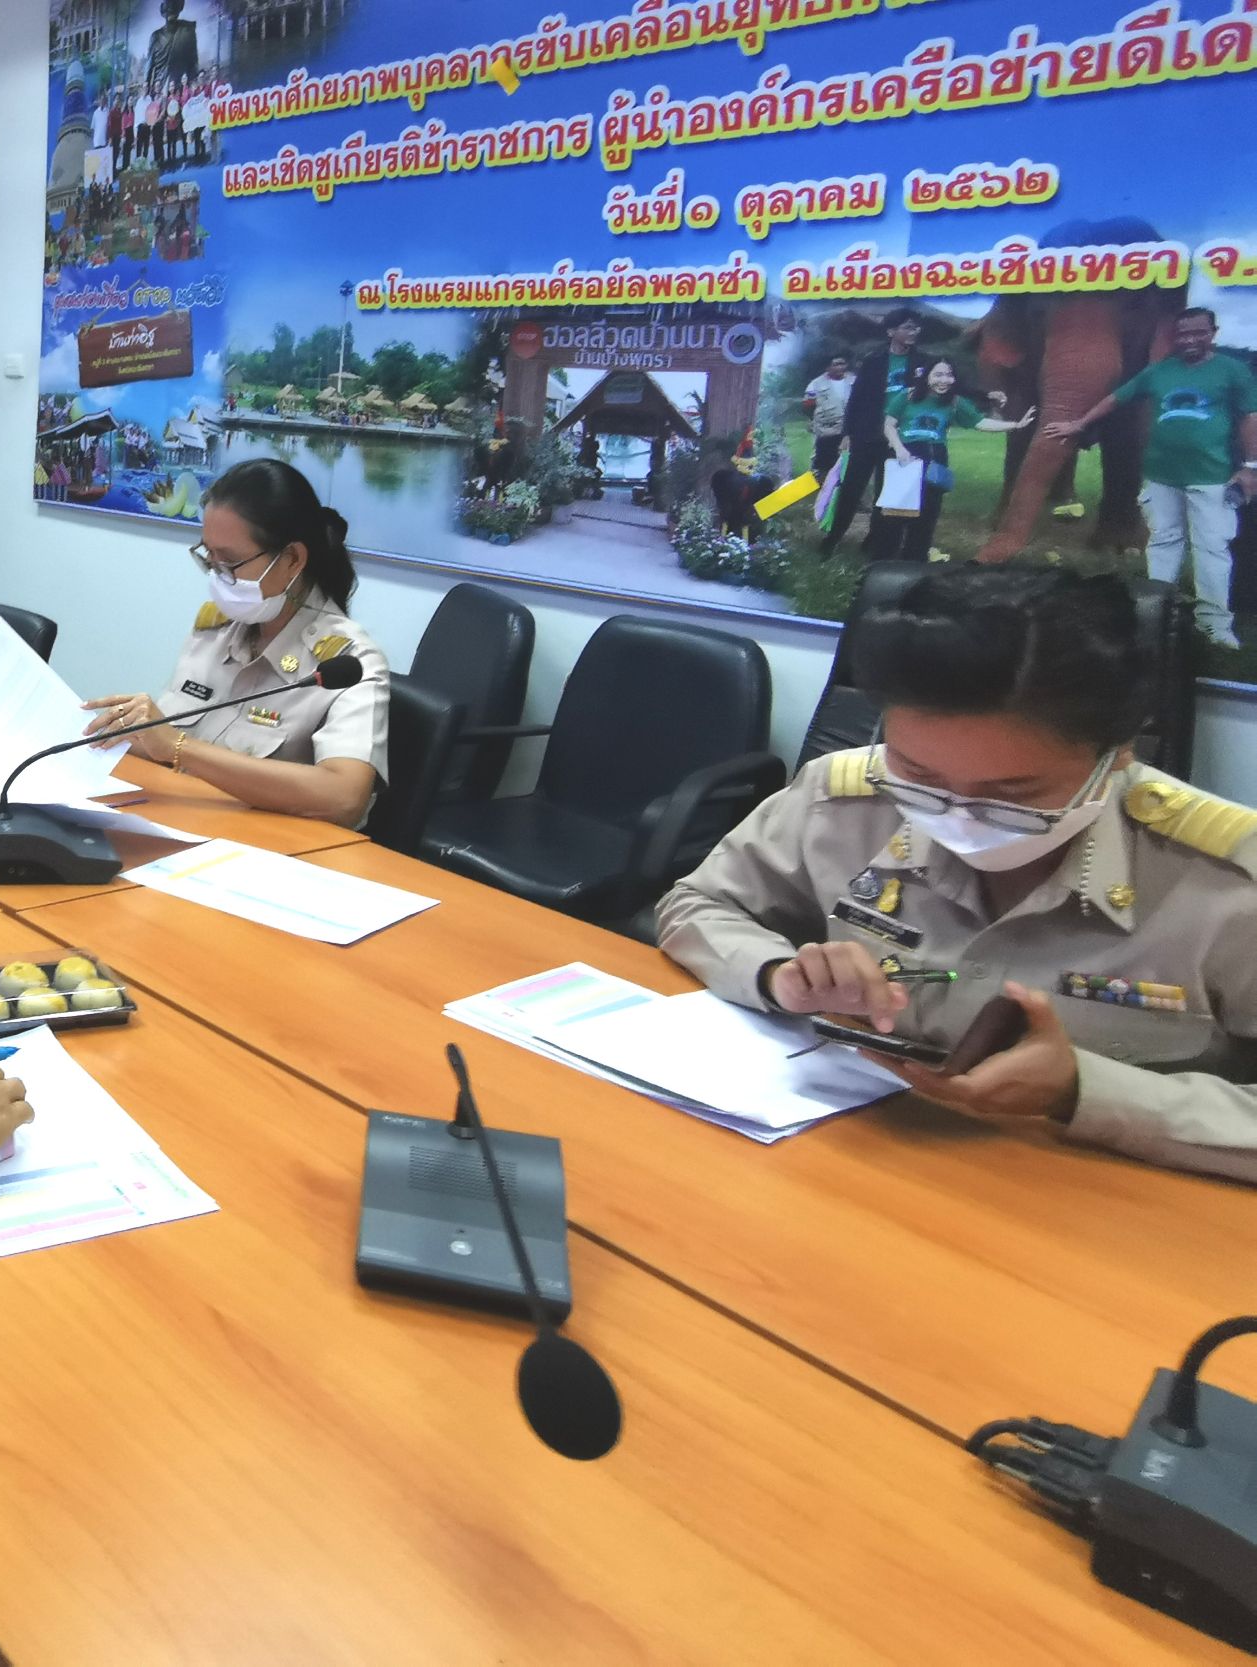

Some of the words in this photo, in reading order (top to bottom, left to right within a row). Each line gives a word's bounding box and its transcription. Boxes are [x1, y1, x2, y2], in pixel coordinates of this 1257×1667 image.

[225, 120, 587, 197] และเชิดชูเกียรติข้าราชการ
[608, 175, 679, 228] วันที่
[690, 201, 714, 222] ๑
[740, 181, 879, 233] ตุลาคม
[911, 167, 1050, 206] ๒๕๖๒
[359, 284, 381, 305] ณ
[387, 258, 761, 304] โรงแรมแกรนด์รอยัลพลาซ่า
[788, 243, 1180, 293] อ.เมืองฉะเชิงเทรา
